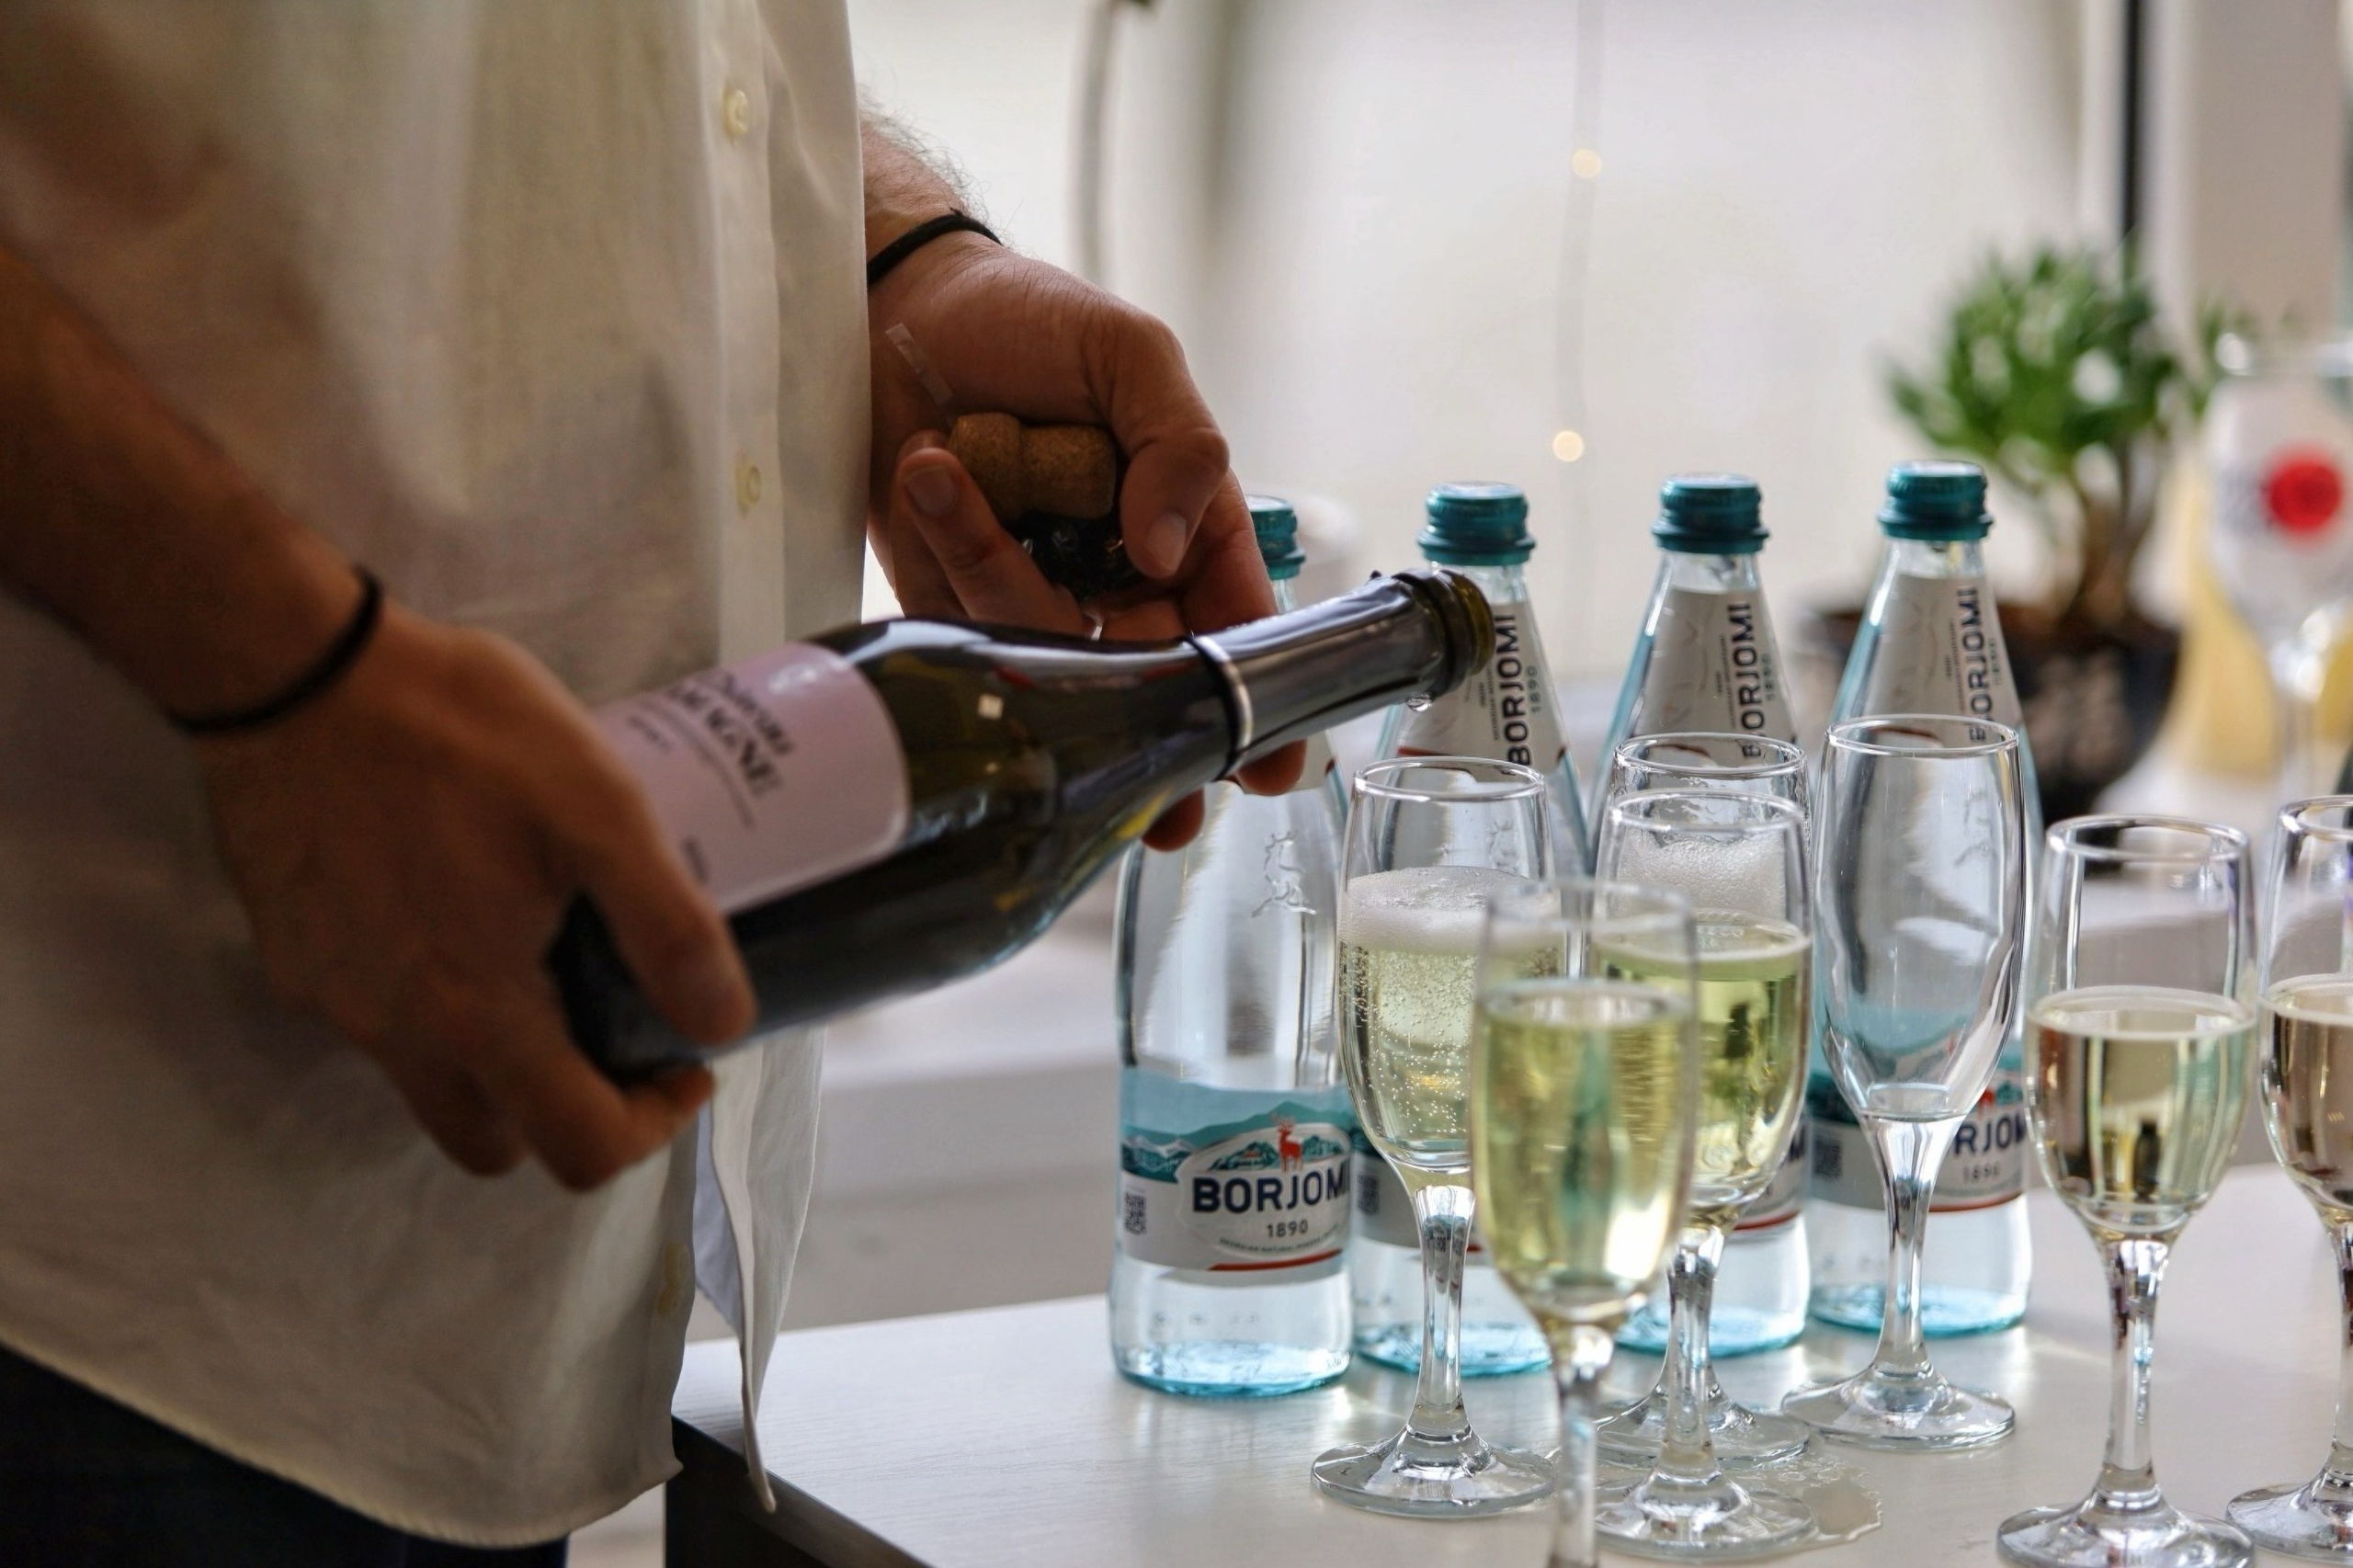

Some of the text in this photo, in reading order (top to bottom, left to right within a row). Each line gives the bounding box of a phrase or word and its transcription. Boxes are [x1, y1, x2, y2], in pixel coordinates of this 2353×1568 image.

[1494, 615, 1531, 767] BORJOMI
[1527, 665, 1540, 712] 1890
[1728, 602, 1764, 756] BORJOMI
[1957, 587, 1993, 742] BORJOMI
[1266, 1219, 1309, 1238] 1890
